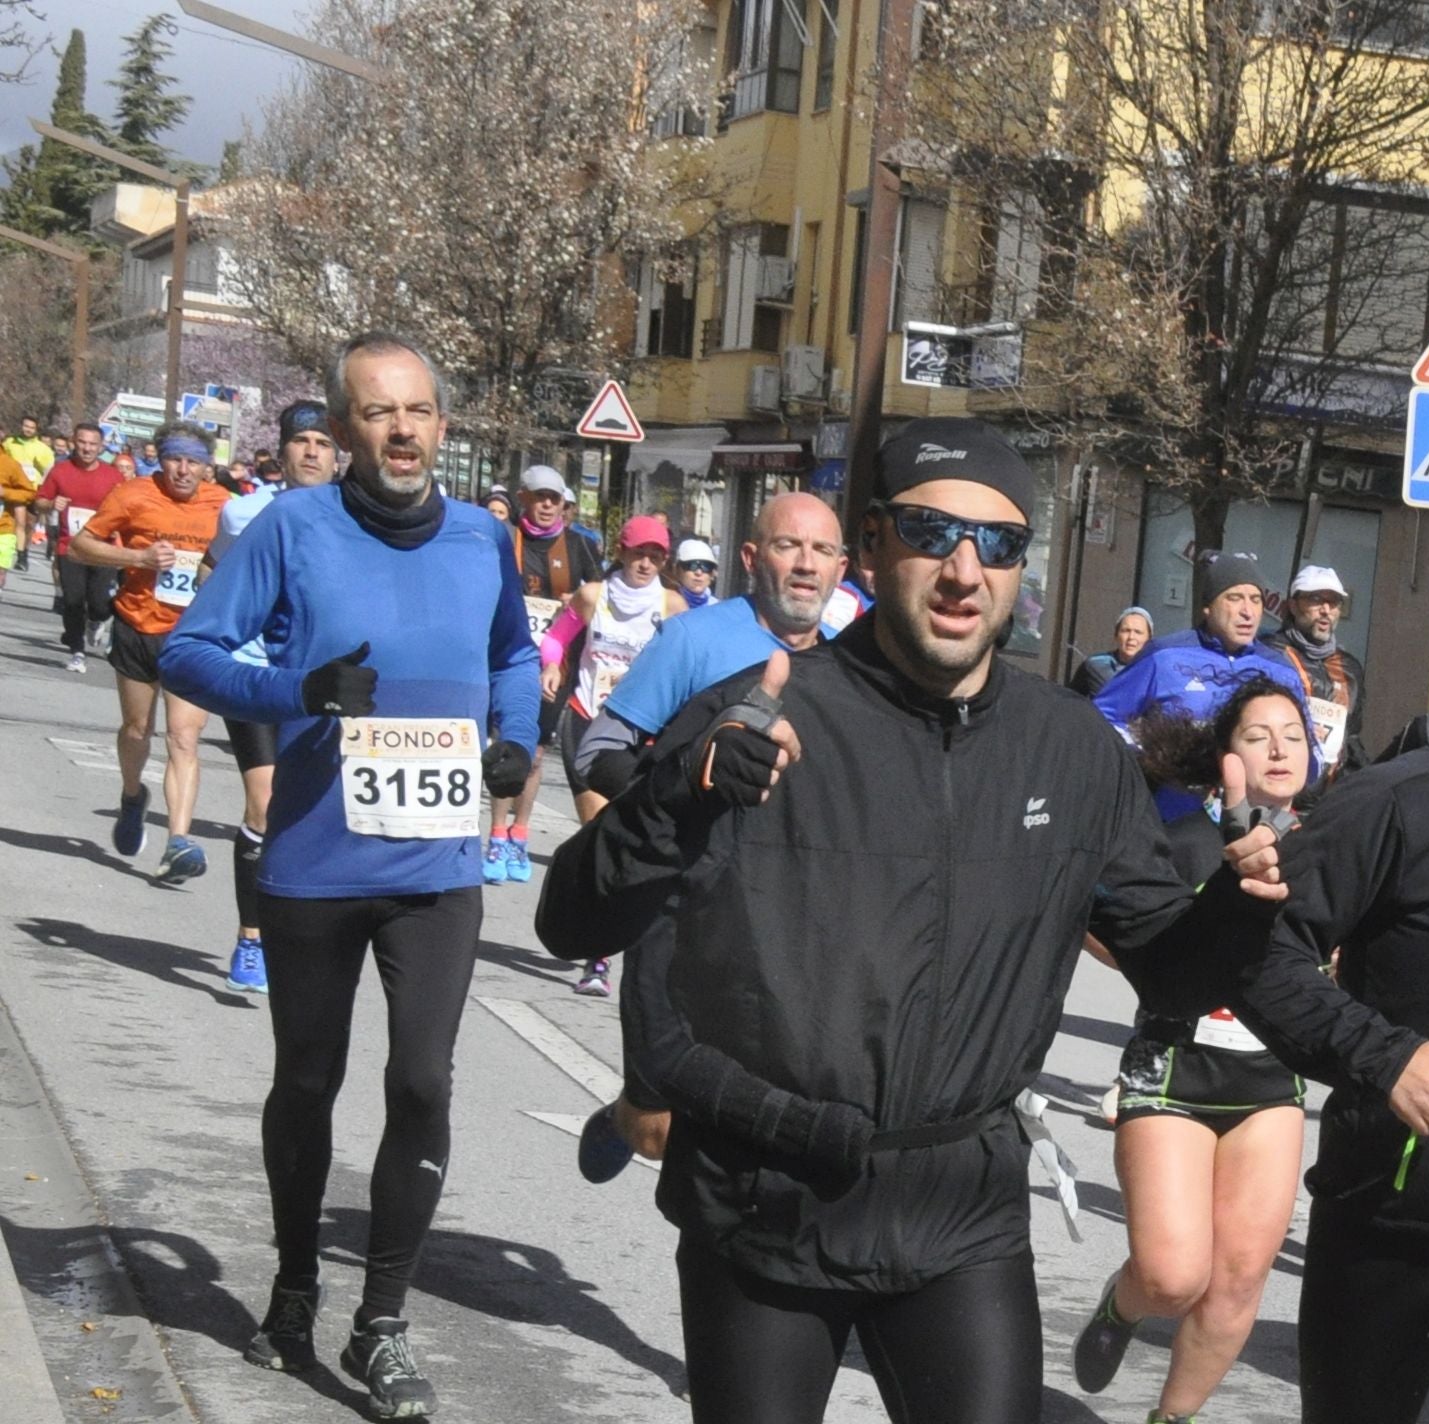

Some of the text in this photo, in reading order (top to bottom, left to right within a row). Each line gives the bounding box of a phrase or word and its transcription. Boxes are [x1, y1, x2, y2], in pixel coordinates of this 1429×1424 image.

[915, 450, 967, 464] Rogelli
[1271, 458, 1377, 492] PENI
[371, 730, 454, 748] FONDO
[353, 767, 471, 807] 3158
